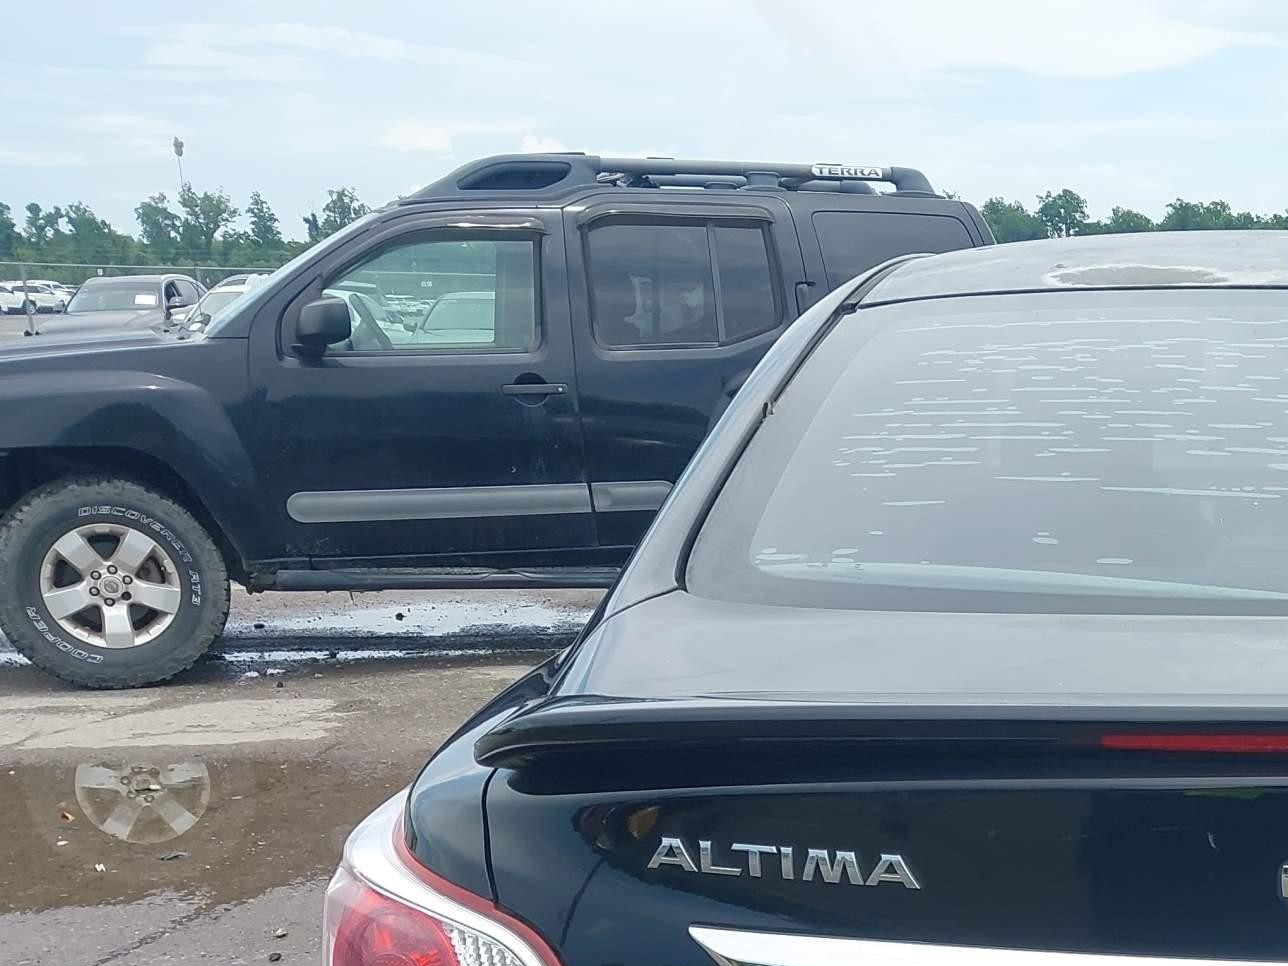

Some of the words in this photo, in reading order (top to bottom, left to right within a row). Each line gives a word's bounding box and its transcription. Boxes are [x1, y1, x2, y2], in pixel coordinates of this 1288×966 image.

[815, 166, 880, 177] TERRA
[78, 506, 192, 563] DISCOVERER
[189, 570, 201, 605] AT3
[26, 606, 103, 664] COOPER
[648, 837, 920, 889] ALTIMA
